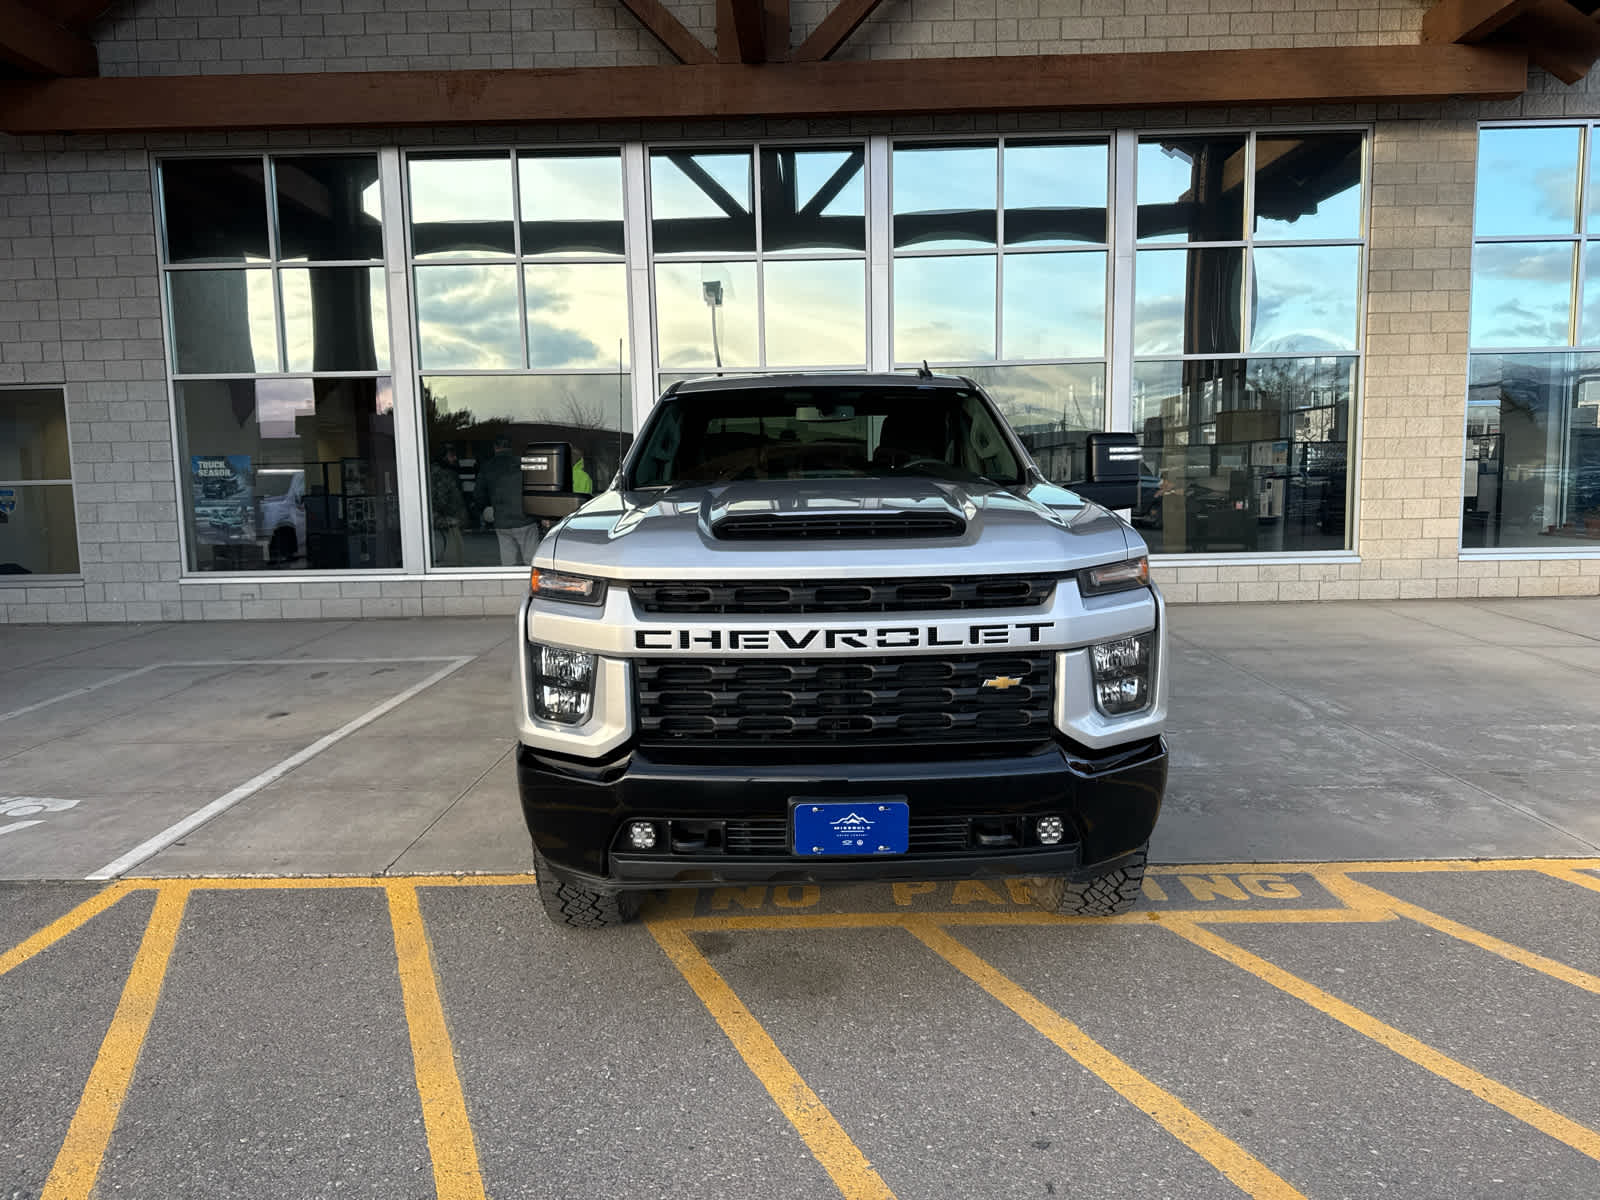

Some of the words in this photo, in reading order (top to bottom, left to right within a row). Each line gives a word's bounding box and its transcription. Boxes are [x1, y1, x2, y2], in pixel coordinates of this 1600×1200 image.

[197, 460, 226, 469] TRUCK
[635, 622, 1055, 650] CHEVROLET
[711, 885, 821, 910] NO
[892, 875, 1303, 906] PAING
